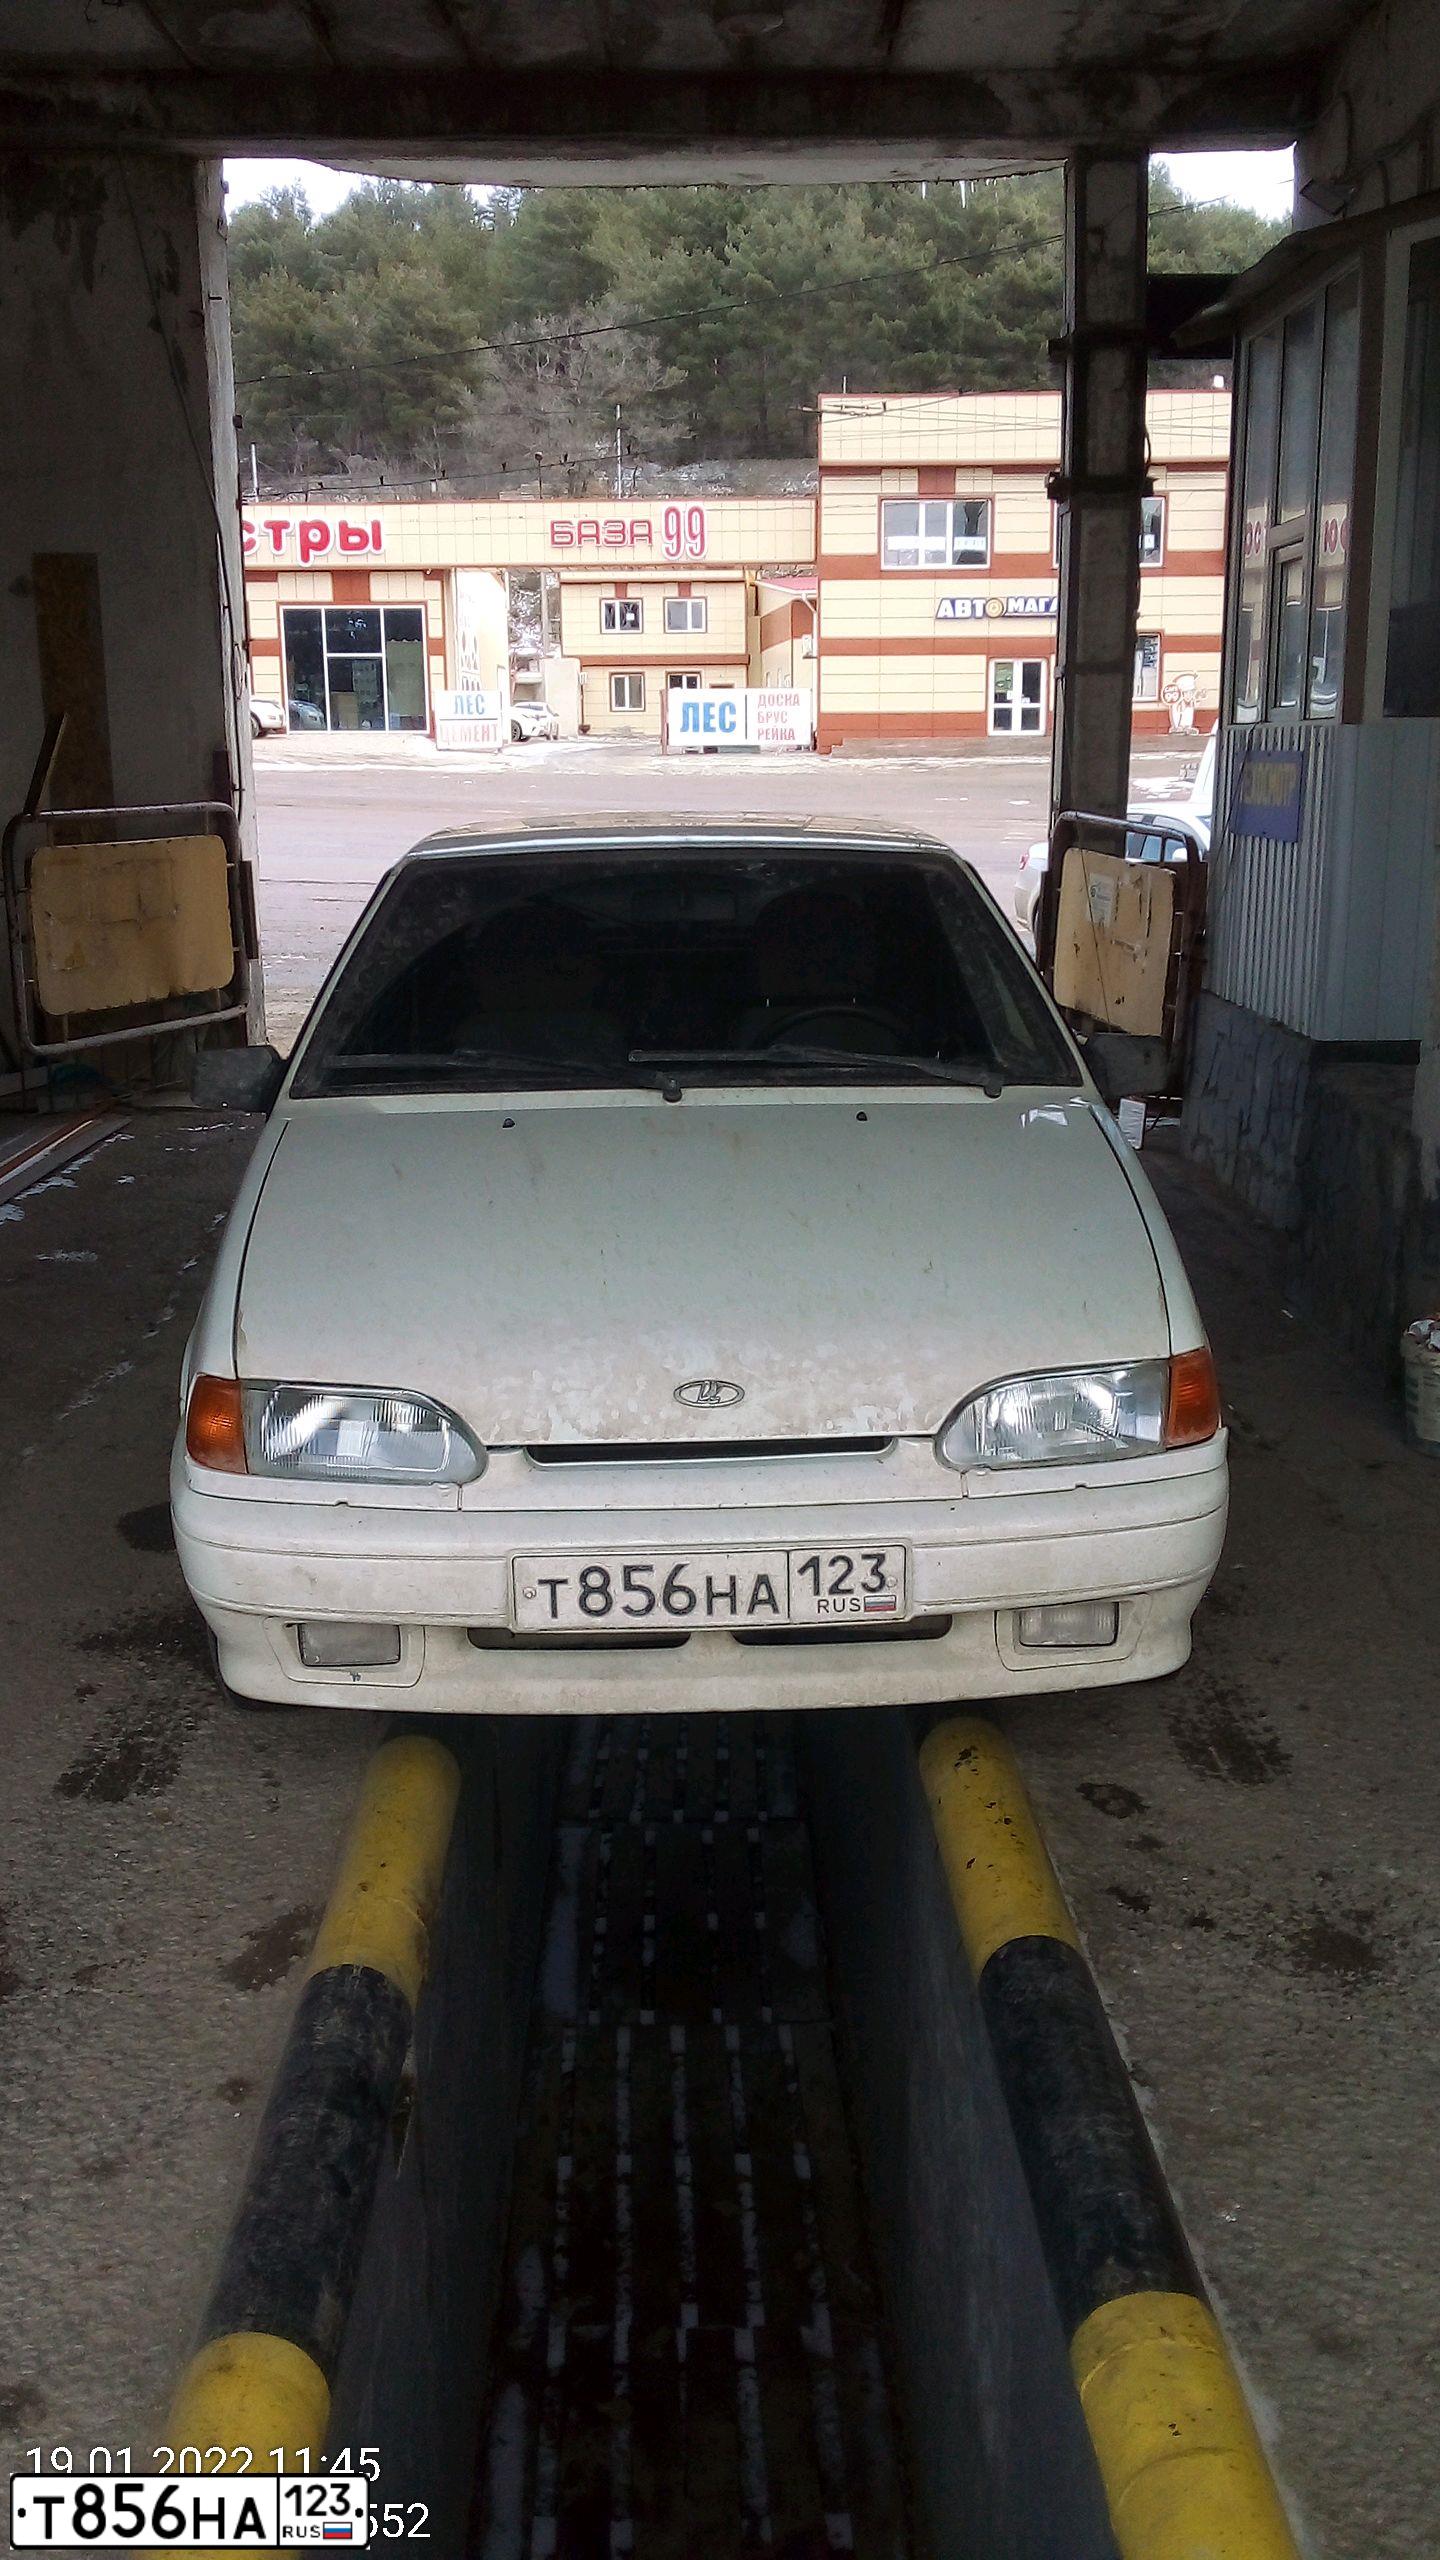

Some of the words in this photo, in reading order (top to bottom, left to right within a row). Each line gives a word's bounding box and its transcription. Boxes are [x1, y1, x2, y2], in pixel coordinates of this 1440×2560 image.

[550, 519, 652, 547] БАЗА
[663, 505, 706, 558] 99
[454, 694, 485, 715] ЛЕС
[757, 693, 801, 708] ДОСКА
[680, 701, 737, 734] ЛЕС
[757, 710, 788, 724] БРУС
[757, 725, 796, 741] РЕЙКА
[538, 1563, 780, 1619] Т856НА
[797, 1553, 888, 1596] 123
[816, 1599, 862, 1614] RUS
